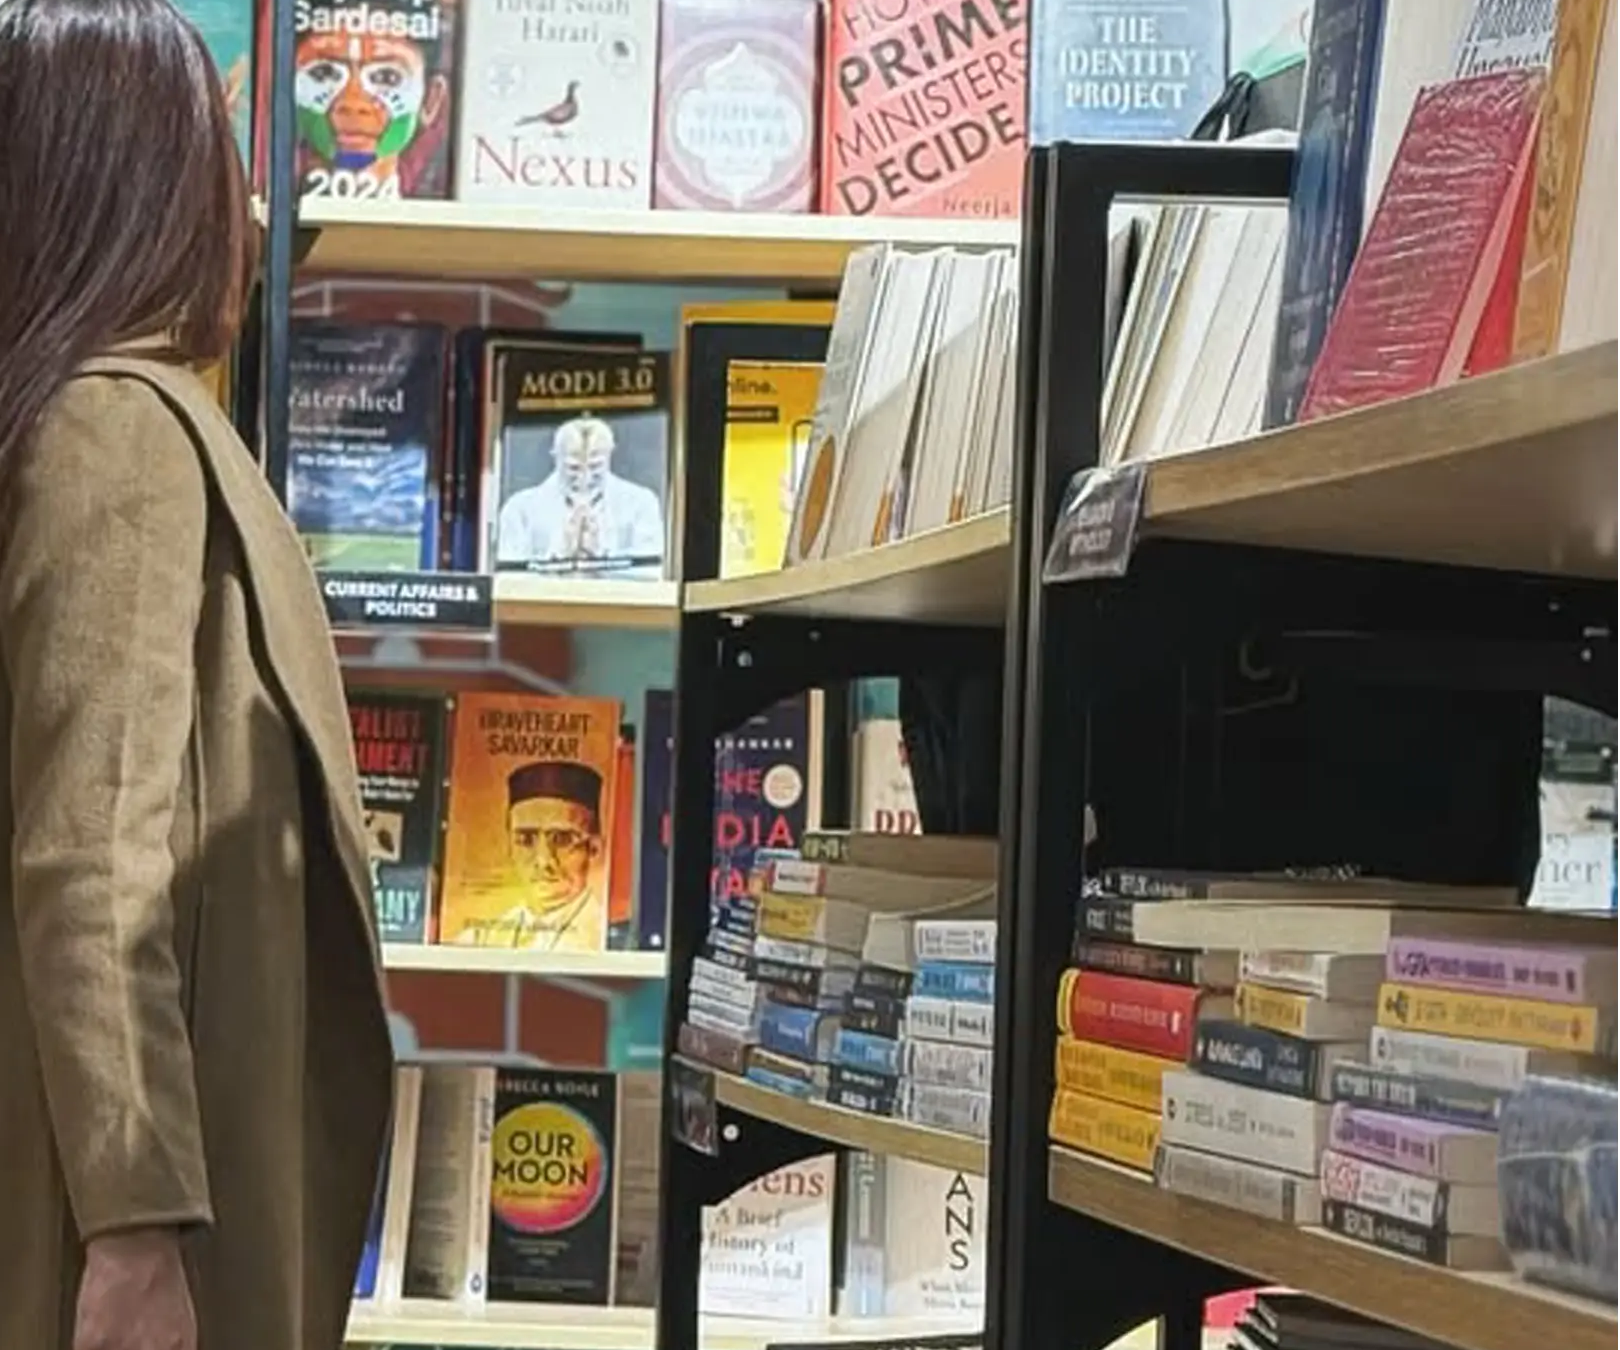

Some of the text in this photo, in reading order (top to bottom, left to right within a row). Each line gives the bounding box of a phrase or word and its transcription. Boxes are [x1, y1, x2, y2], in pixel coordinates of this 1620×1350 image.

[294, 0, 440, 40] Sardesai
[522, 16, 600, 44] Harari
[1097, 16, 1158, 44] THE
[1059, 48, 1196, 77] IDENTITY
[833, 38, 1028, 168] MINISTERS
[1065, 80, 1189, 115] PROJECT
[473, 135, 640, 189] Nexus
[836, 103, 1027, 217] DECIDE
[306, 168, 401, 199] 2024
[521, 365, 654, 395] MODI 3.0
[325, 580, 479, 602] CURRENT AFFAIRS &
[365, 600, 437, 618] POLITICS
[481, 710, 592, 735] BRAVEHEART
[487, 733, 579, 758] SAVARKAR
[508, 1130, 576, 1158] OUR
[492, 1160, 589, 1186] MOON
[736, 1208, 784, 1228] Brief
